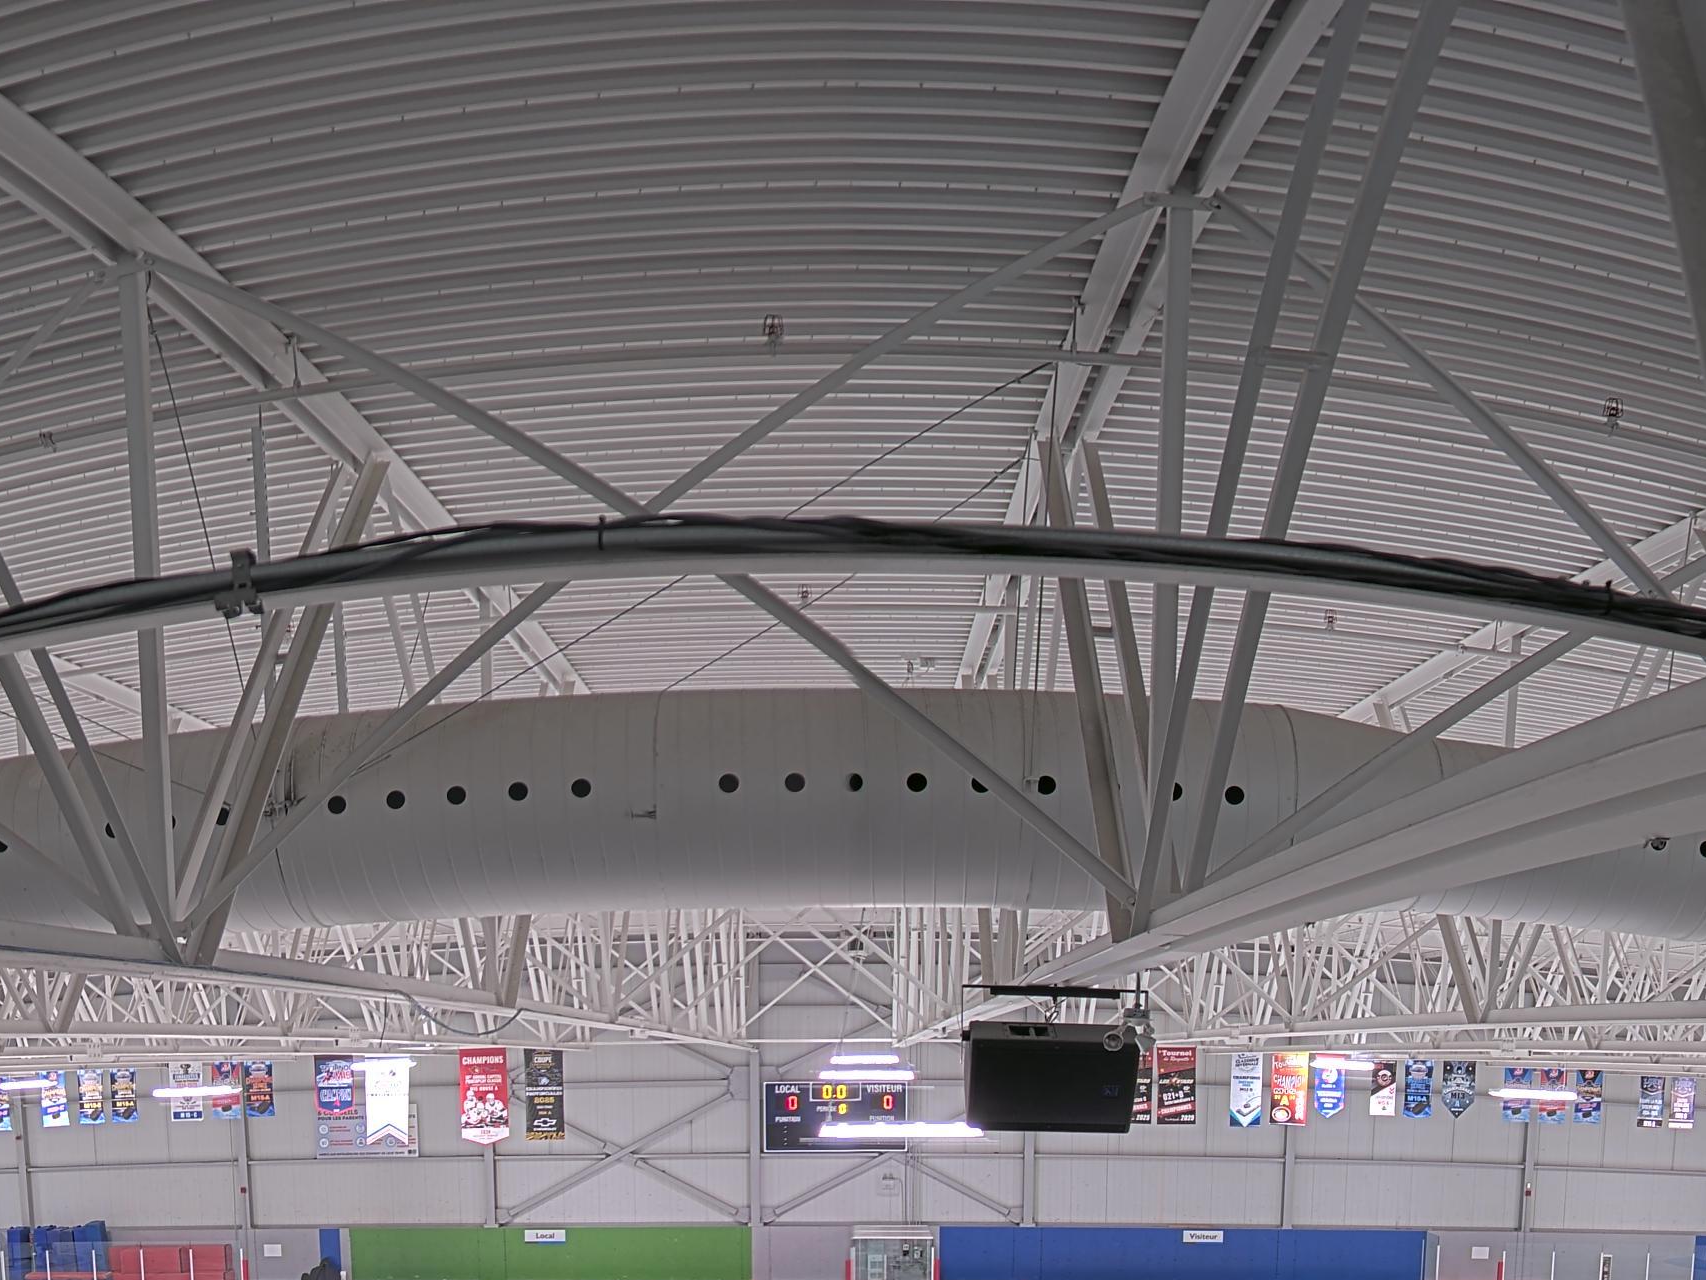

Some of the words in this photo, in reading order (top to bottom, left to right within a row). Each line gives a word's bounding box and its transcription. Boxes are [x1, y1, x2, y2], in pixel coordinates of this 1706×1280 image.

[462, 1056, 504, 1065] CHAMPIONS
[775, 1085, 801, 1094] LOCAL
[867, 1084, 903, 1093] VISITEUR
[1450, 1092, 1466, 1100] M13
[786, 1096, 798, 1111] 0
[883, 1095, 894, 1111] 0
[837, 1103, 847, 1115] 0
[1189, 1232, 1218, 1240] Visiteur
